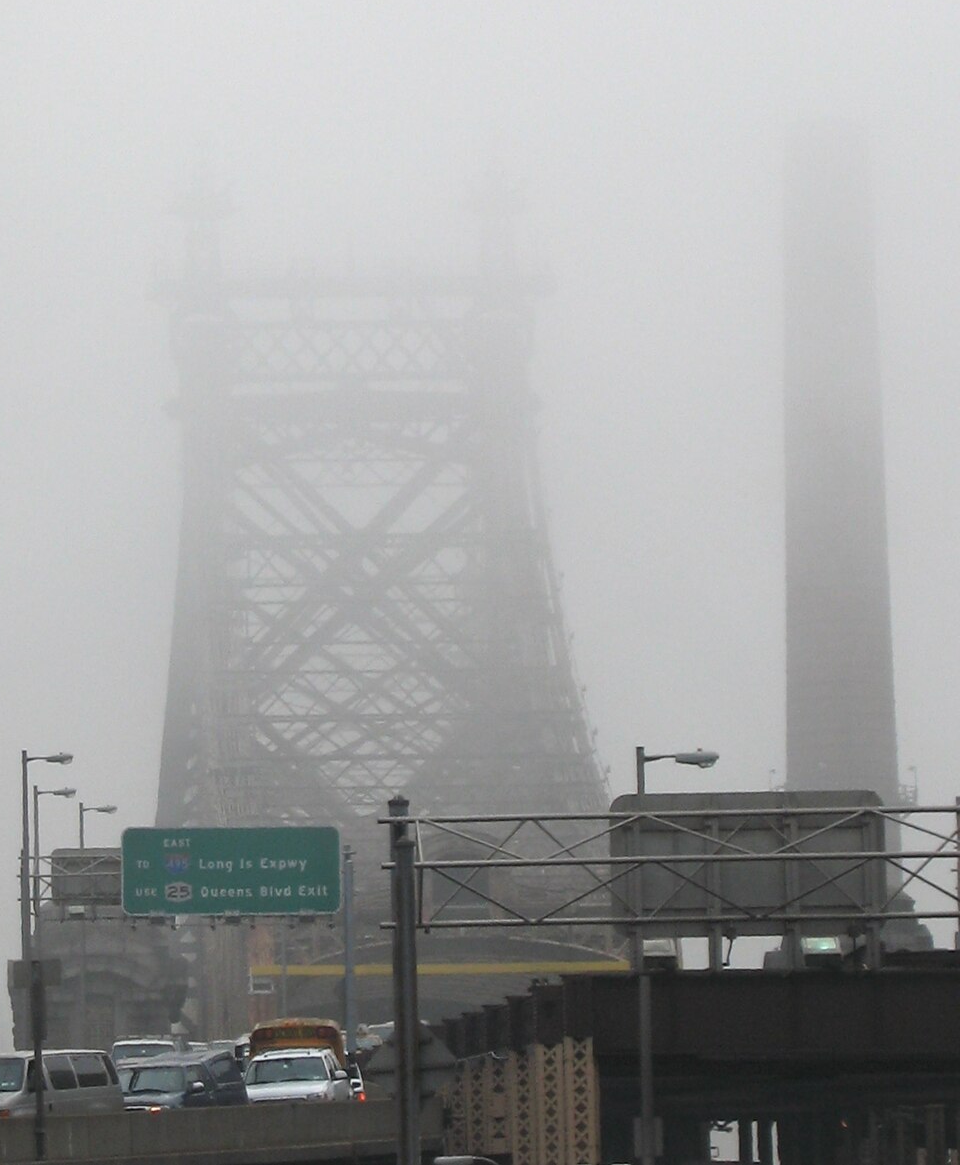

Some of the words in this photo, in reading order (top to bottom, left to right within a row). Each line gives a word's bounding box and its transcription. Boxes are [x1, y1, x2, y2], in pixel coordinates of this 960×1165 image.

[163, 838, 191, 848] EAST
[136, 859, 150, 869] TO
[199, 858, 233, 873] Long
[240, 858, 253, 869] Is
[260, 858, 308, 872] Expwy
[135, 887, 158, 897] USE
[167, 886, 190, 898] 25
[200, 886, 253, 899] Queens
[260, 885, 292, 898] Blvd
[298, 885, 329, 897] Exit
